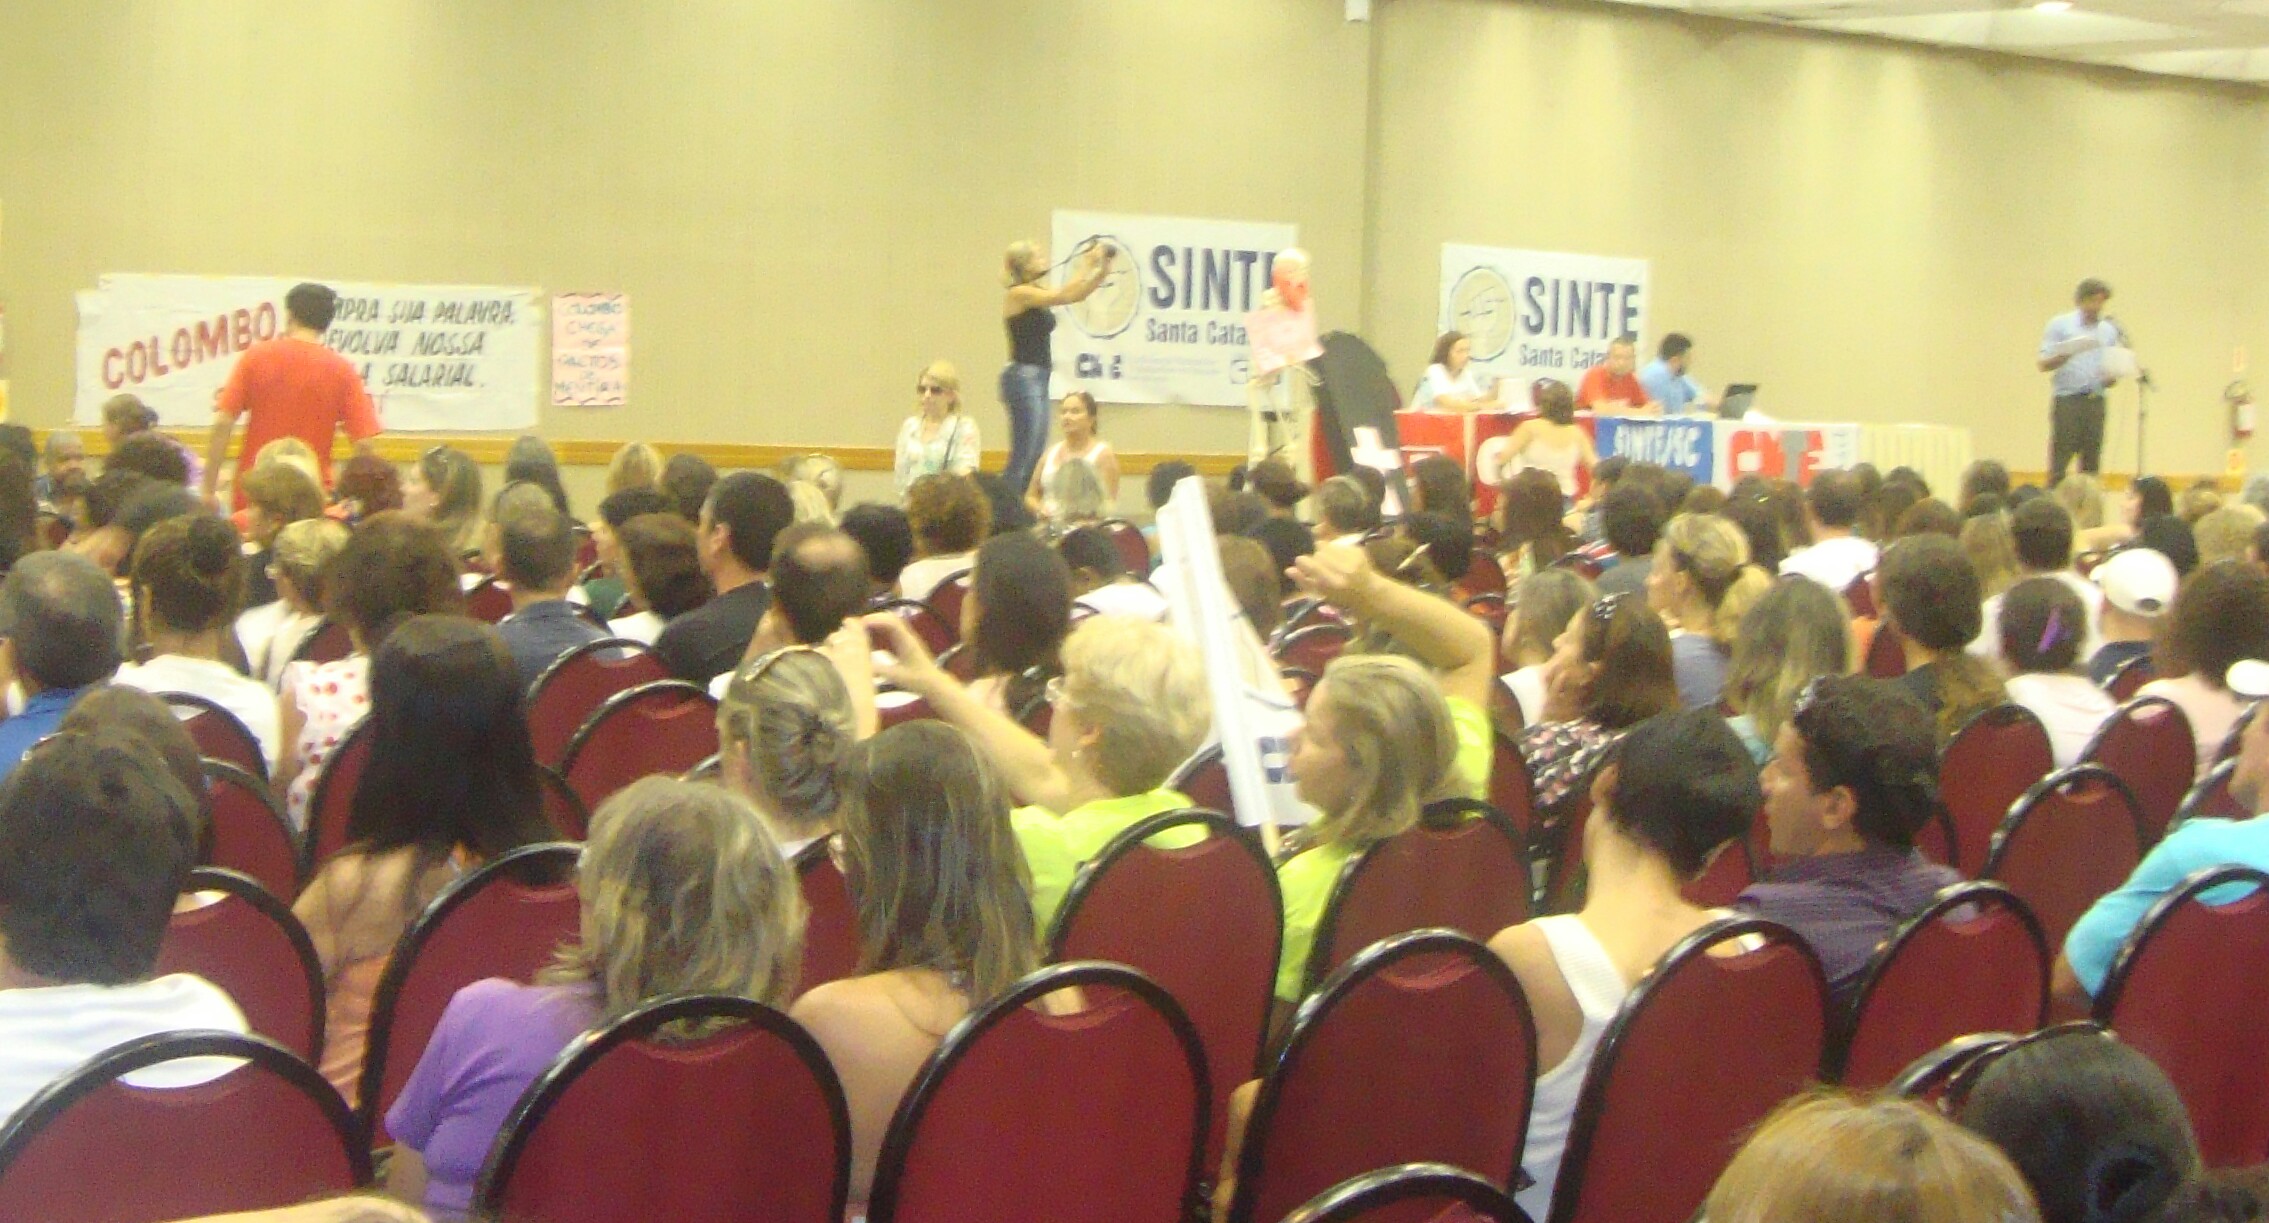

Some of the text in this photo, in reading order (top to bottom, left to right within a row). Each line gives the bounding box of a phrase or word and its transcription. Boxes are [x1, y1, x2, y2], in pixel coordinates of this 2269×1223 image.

[388, 299, 426, 324] SUA
[1520, 275, 1640, 341] SINTE
[410, 329, 487, 357] NOSSA
[1146, 318, 1248, 345] Santa Cata
[1518, 343, 1608, 369] Santa Cata
